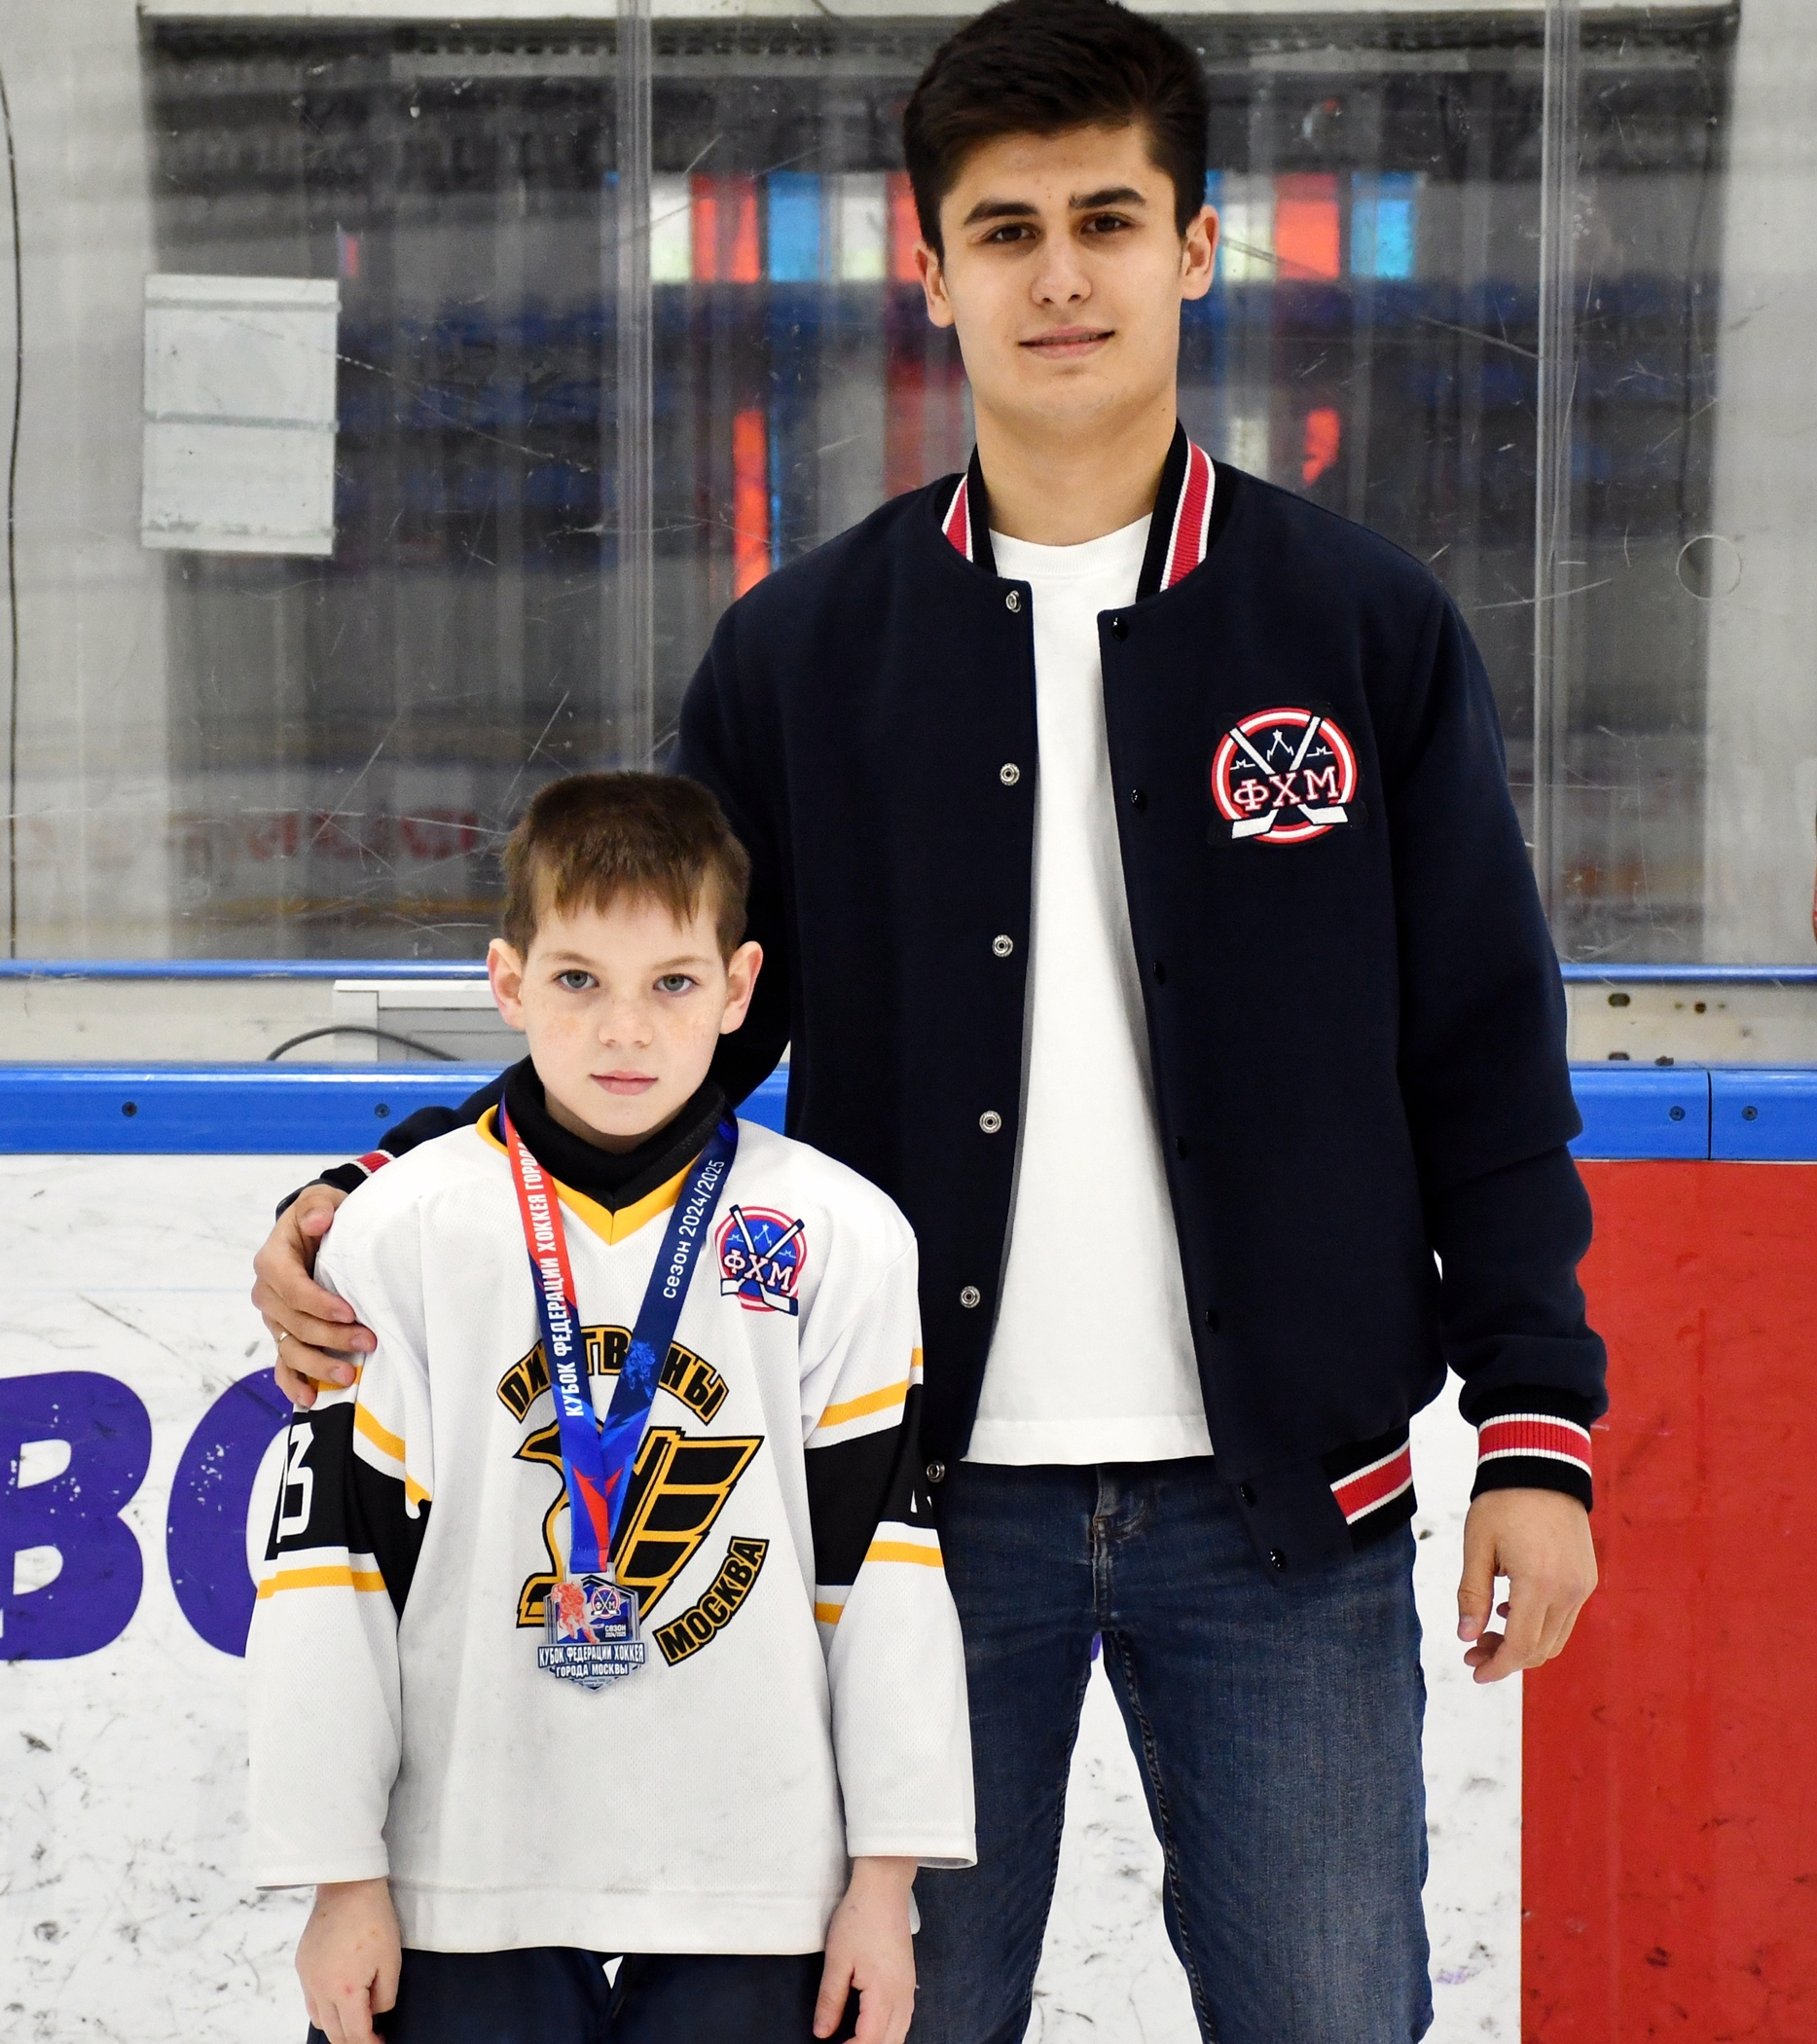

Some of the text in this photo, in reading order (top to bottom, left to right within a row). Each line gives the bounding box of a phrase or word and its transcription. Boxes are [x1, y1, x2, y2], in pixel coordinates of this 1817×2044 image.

[1233, 766, 1340, 811] ФХМ
[527, 1193, 557, 1253] ХОККЕЯ
[663, 1159, 725, 1299] сезон 2024/2025
[723, 1249, 793, 1291] ФХМ
[539, 1258, 572, 1357] ФЕДЕРАЦИИ
[556, 1362, 584, 1417] КУБОК
[653, 1536, 770, 1666] МОСКВА
[539, 1643, 644, 1667] КУБОК ФЕДЕРАЦИИ ХОККЕЯ
[556, 1662, 628, 1678] ГОРОДА МОСКВЫ
